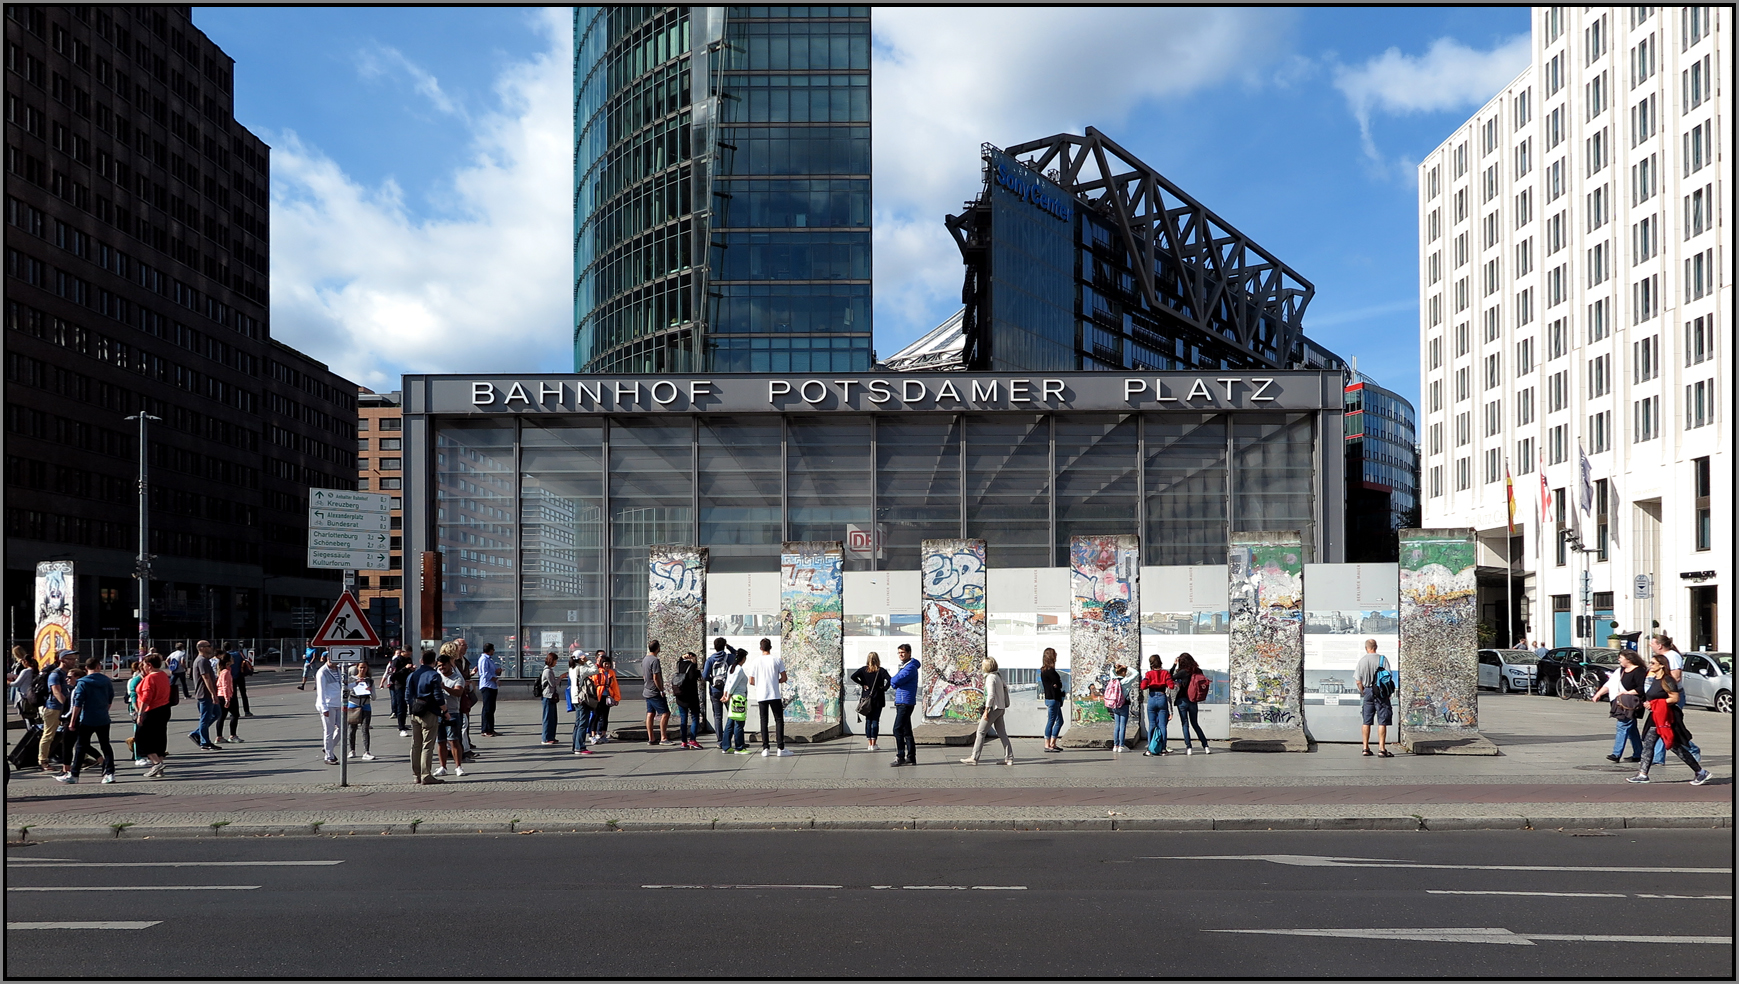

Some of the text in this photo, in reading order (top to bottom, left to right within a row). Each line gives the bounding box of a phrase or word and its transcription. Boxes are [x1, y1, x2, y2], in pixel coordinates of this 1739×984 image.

[997, 163, 1075, 221] Sony Center
[472, 378, 1275, 404] BAHNHOF POTSDAMER PLATZ
[327, 500, 360, 509] Kreuzberg
[327, 512, 364, 520] Alexanderplatz
[327, 520, 359, 528] Bundesrat
[313, 531, 358, 540] Charlottenburg
[313, 539, 351, 548] Schöneberg
[313, 550, 351, 559] Siegessäule
[312, 559, 351, 567] Kulturforum
